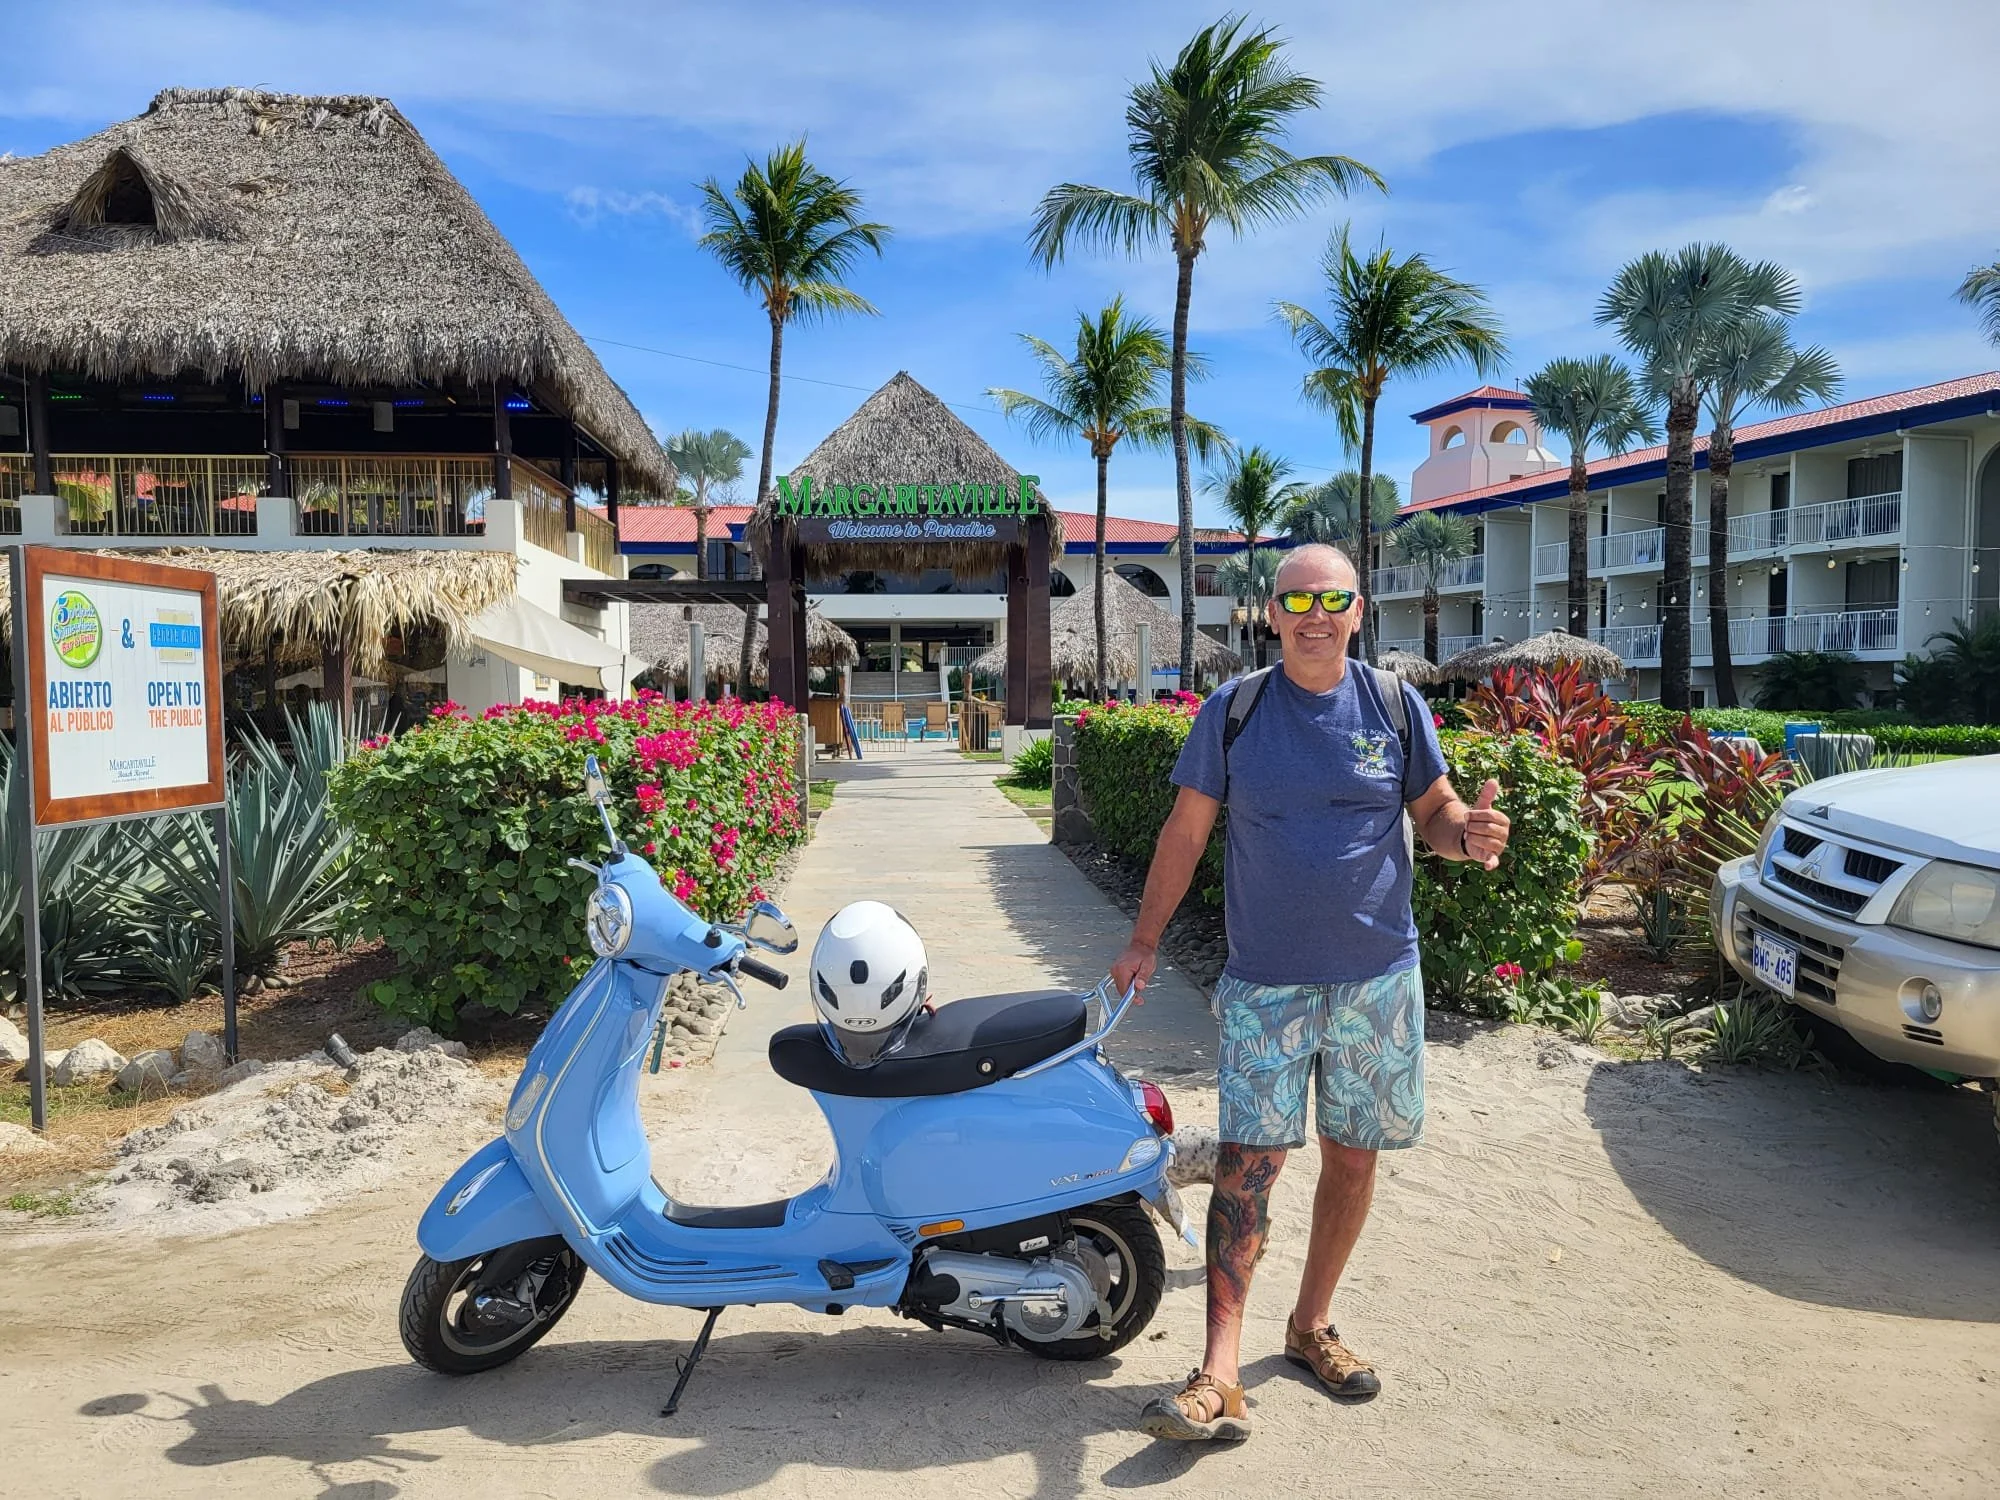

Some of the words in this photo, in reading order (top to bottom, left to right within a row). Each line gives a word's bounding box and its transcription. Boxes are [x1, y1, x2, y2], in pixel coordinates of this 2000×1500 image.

[776, 475, 1041, 516] MARGARITAVILLE
[828, 520, 903, 539] Welcome
[902, 520, 922, 538] to
[922, 519, 997, 538] Paradise
[121, 618, 135, 649] &
[49, 681, 112, 709] ABIERTO
[148, 681, 182, 707] OPEN
[185, 681, 201, 706] TO
[50, 712, 64, 733] AL
[149, 710, 168, 728] THE
[170, 709, 203, 728] PUBLIC
